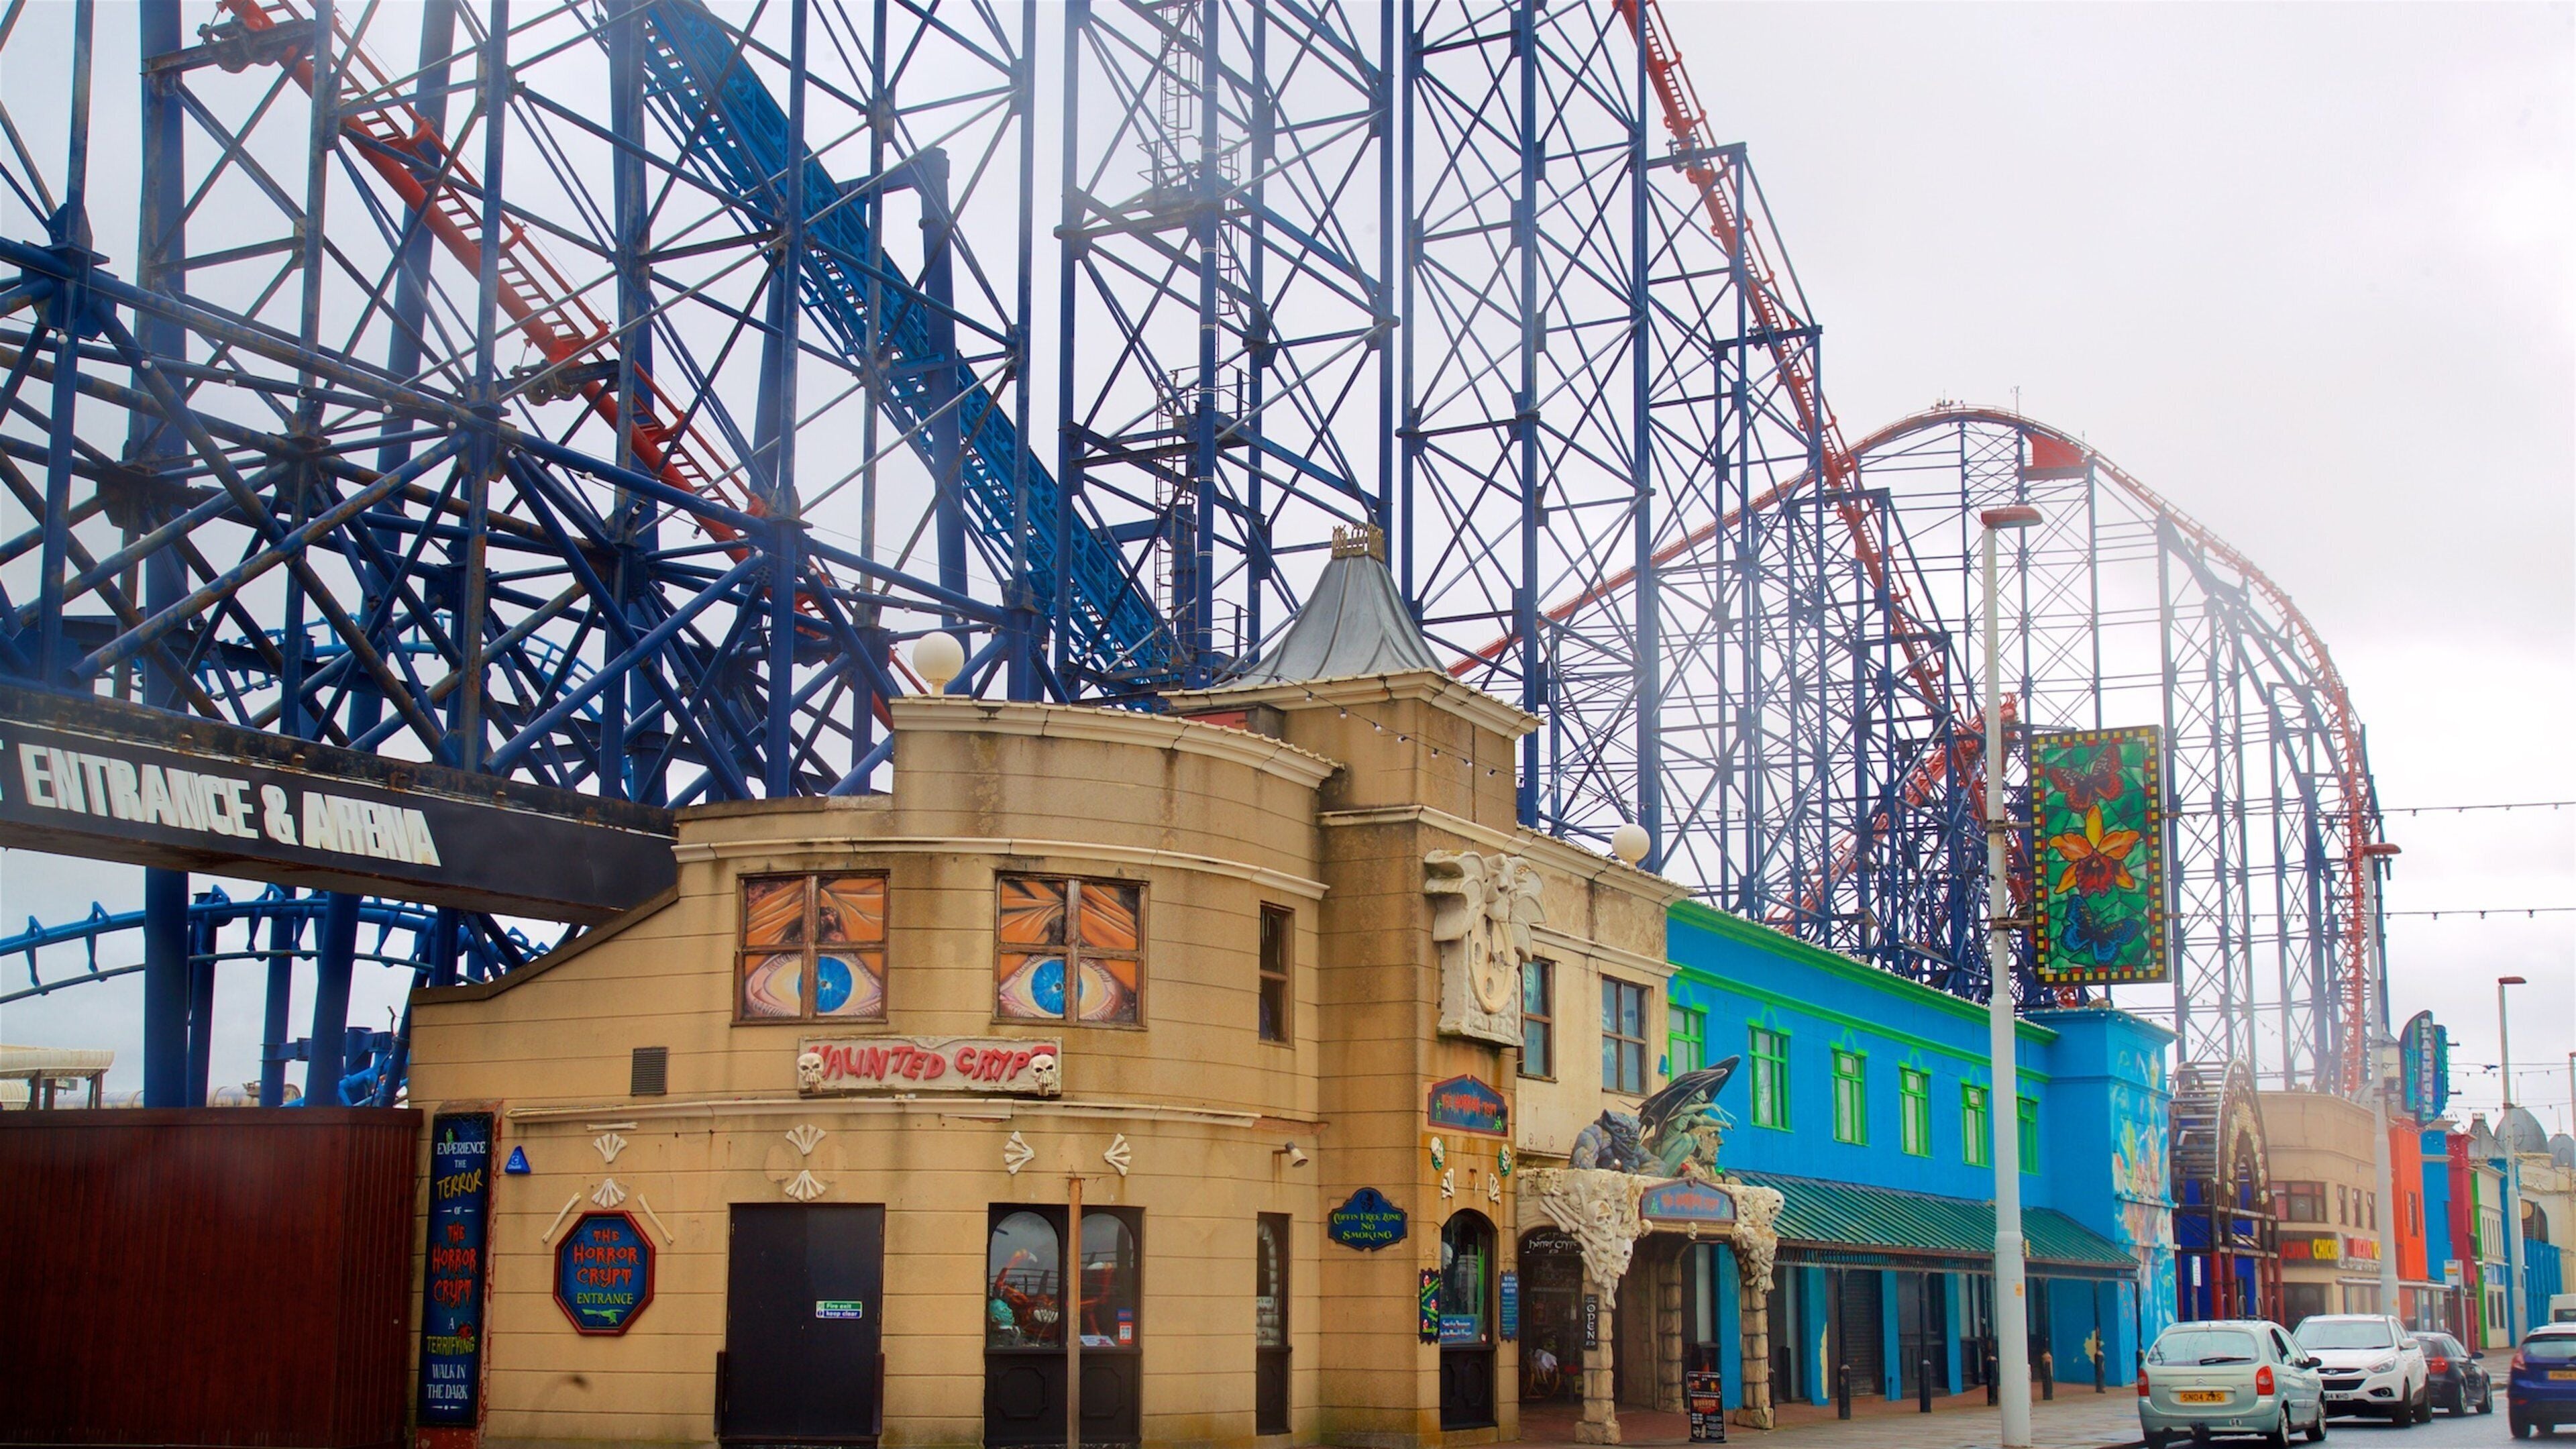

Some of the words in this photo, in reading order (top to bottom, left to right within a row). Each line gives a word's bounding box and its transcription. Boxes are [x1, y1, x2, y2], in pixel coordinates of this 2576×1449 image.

[18, 743, 259, 839] ENTRANCE
[260, 784, 299, 845] &
[303, 791, 441, 867] ARENA
[437, 1141, 486, 1155] EXPERIENCE
[454, 1159, 467, 1169] THE
[437, 1168, 483, 1201] TERROR
[453, 1206, 462, 1215] OF
[1360, 1213, 1380, 1223] FREE
[1383, 1213, 1402, 1222] ZONE
[447, 1222, 466, 1245] THE
[592, 1228, 621, 1242] THE
[1342, 1230, 1393, 1241] SMOKING
[432, 1242, 478, 1275] HORROR
[573, 1240, 641, 1266] HORROR
[576, 1266, 633, 1288] CRYPT
[433, 1277, 472, 1308] CRYPT
[576, 1292, 634, 1305] ENTRANCE
[449, 1317, 455, 1330] A
[427, 1335, 475, 1355] TERRIFYING
[432, 1363, 455, 1379] WALK
[456, 1364, 466, 1379] IN
[427, 1384, 444, 1399] THE
[445, 1384, 468, 1399] DARK
[2182, 1393, 2204, 1402] SN04
